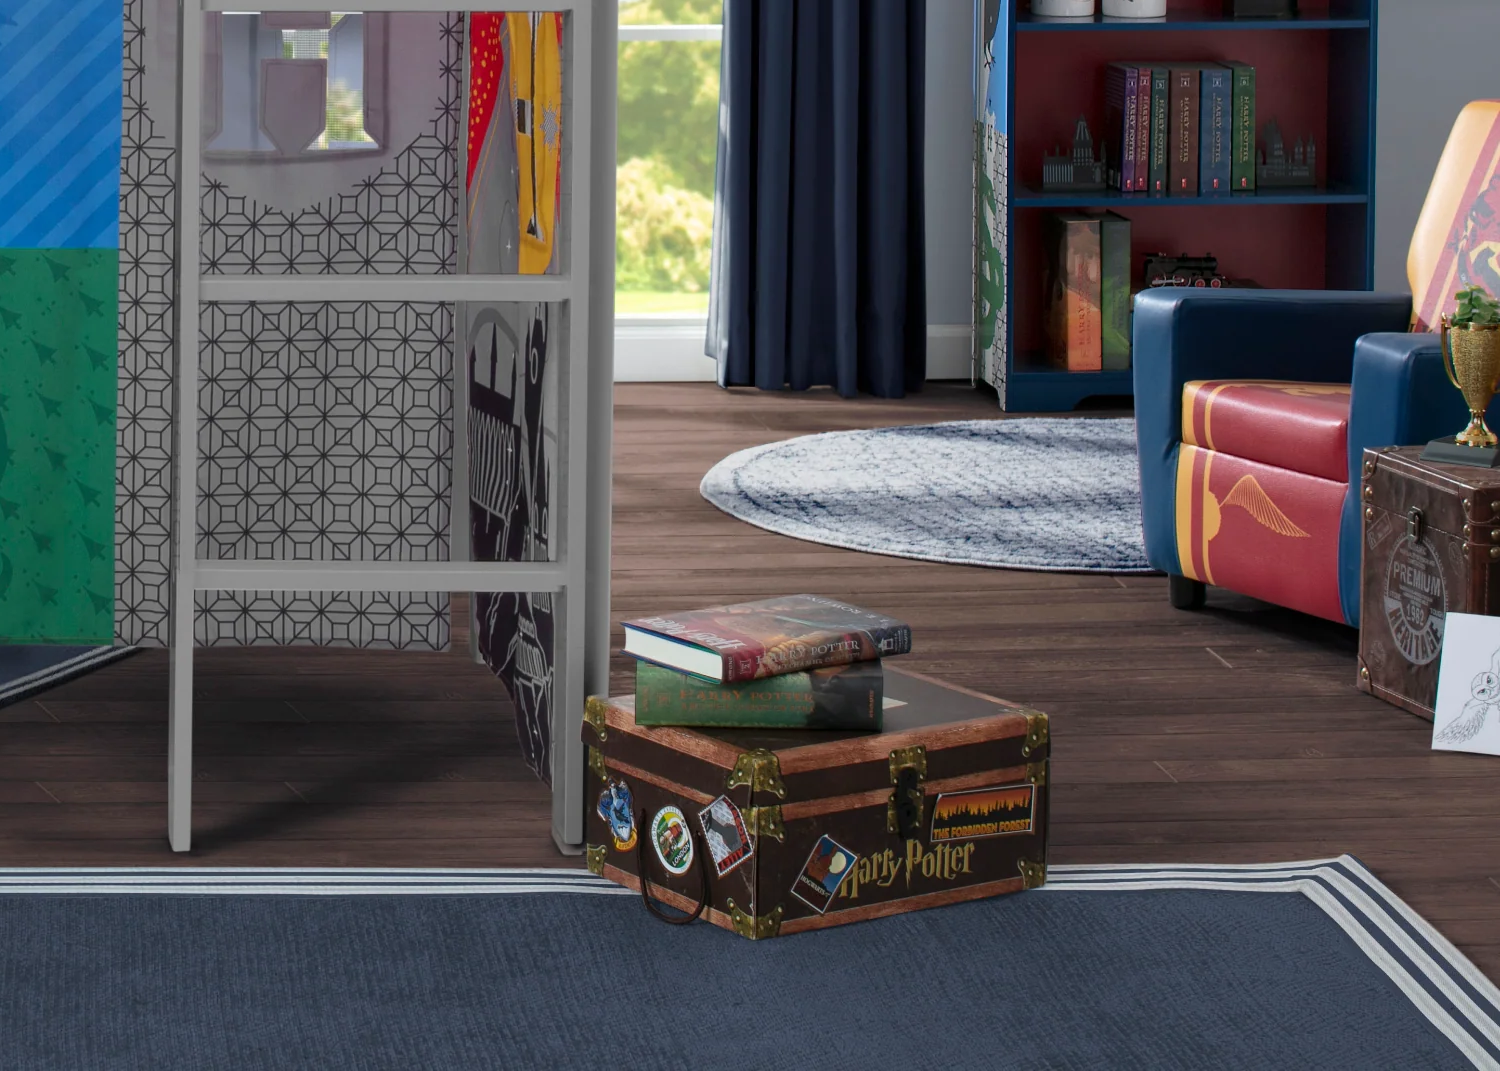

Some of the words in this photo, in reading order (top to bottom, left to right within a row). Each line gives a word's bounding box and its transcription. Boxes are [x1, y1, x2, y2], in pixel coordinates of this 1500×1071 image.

[1393, 561, 1441, 597] PREMIUM
[1406, 605, 1425, 626] 1982
[1388, 607, 1443, 660] HERITAGE
[755, 646, 806, 665] HARRY
[811, 640, 860, 656] POTTER
[679, 689, 743, 702] HARRY
[750, 691, 815, 703] POTTER
[933, 828, 950, 839] THE
[951, 822, 998, 837] FORBIDDEN
[1000, 818, 1031, 832] FOREST
[672, 842, 691, 867] LONDON
[718, 847, 744, 871] ALLEY
[838, 847, 903, 900] Harry
[905, 839, 976, 890] Potter
